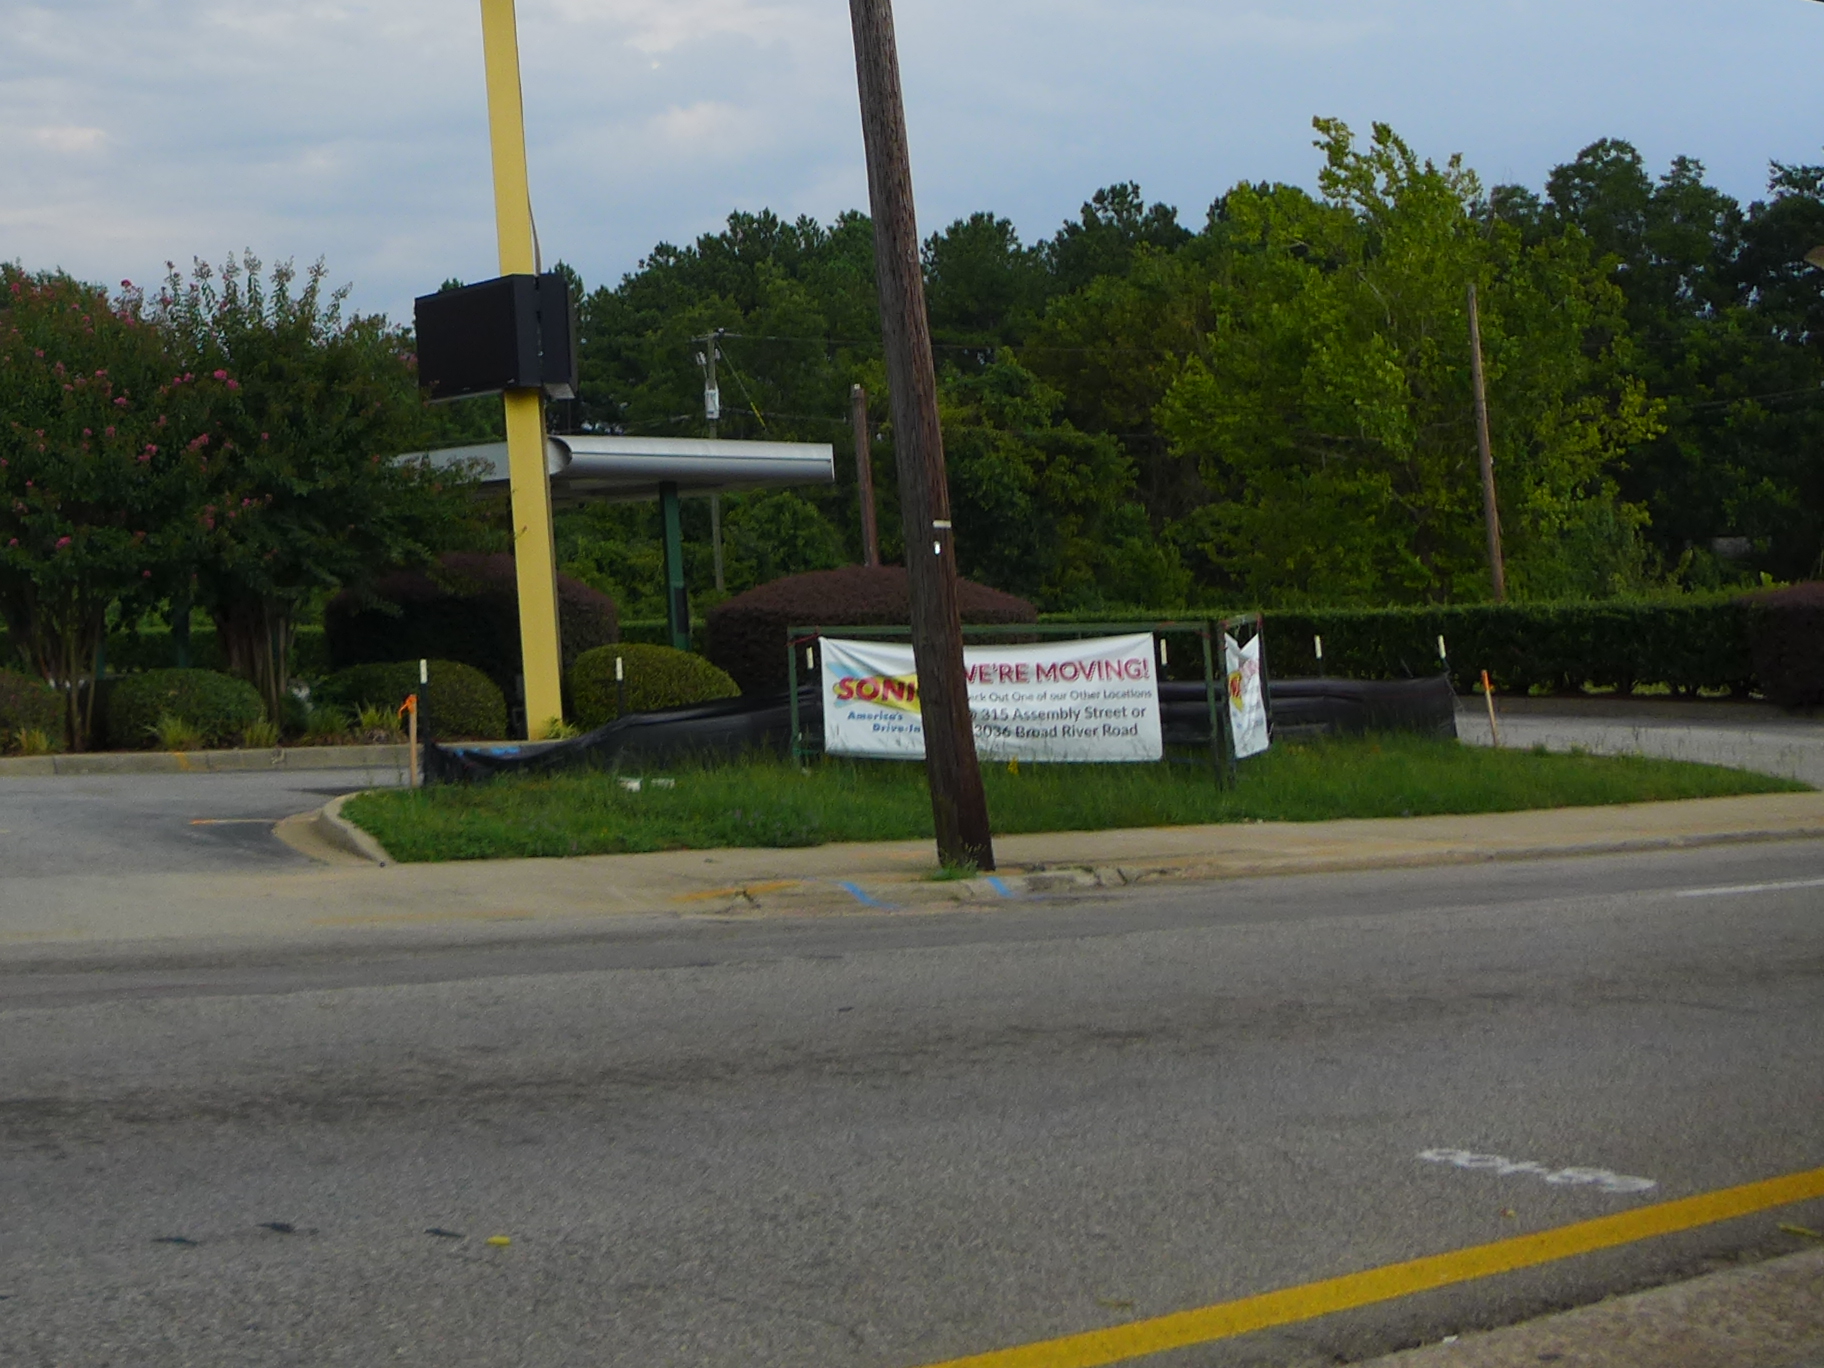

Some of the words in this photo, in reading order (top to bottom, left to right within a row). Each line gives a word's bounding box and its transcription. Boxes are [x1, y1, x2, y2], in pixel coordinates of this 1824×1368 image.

[1036, 658, 1150, 683] MOVING!
[837, 676, 915, 702] SONI
[989, 692, 1009, 702] Out
[1012, 692, 1034, 702] One
[1036, 691, 1047, 702] of
[1050, 693, 1067, 701] our
[1070, 690, 1100, 701] Other
[1104, 689, 1152, 700] Locations
[848, 711, 903, 721] America's
[981, 707, 1009, 720] 315
[1013, 707, 1081, 722] Assembly
[1085, 706, 1127, 719] Street
[1132, 707, 1147, 718] or
[1016, 724, 1057, 738] Broad
[1061, 724, 1099, 738] River
[1103, 723, 1138, 737] Road
